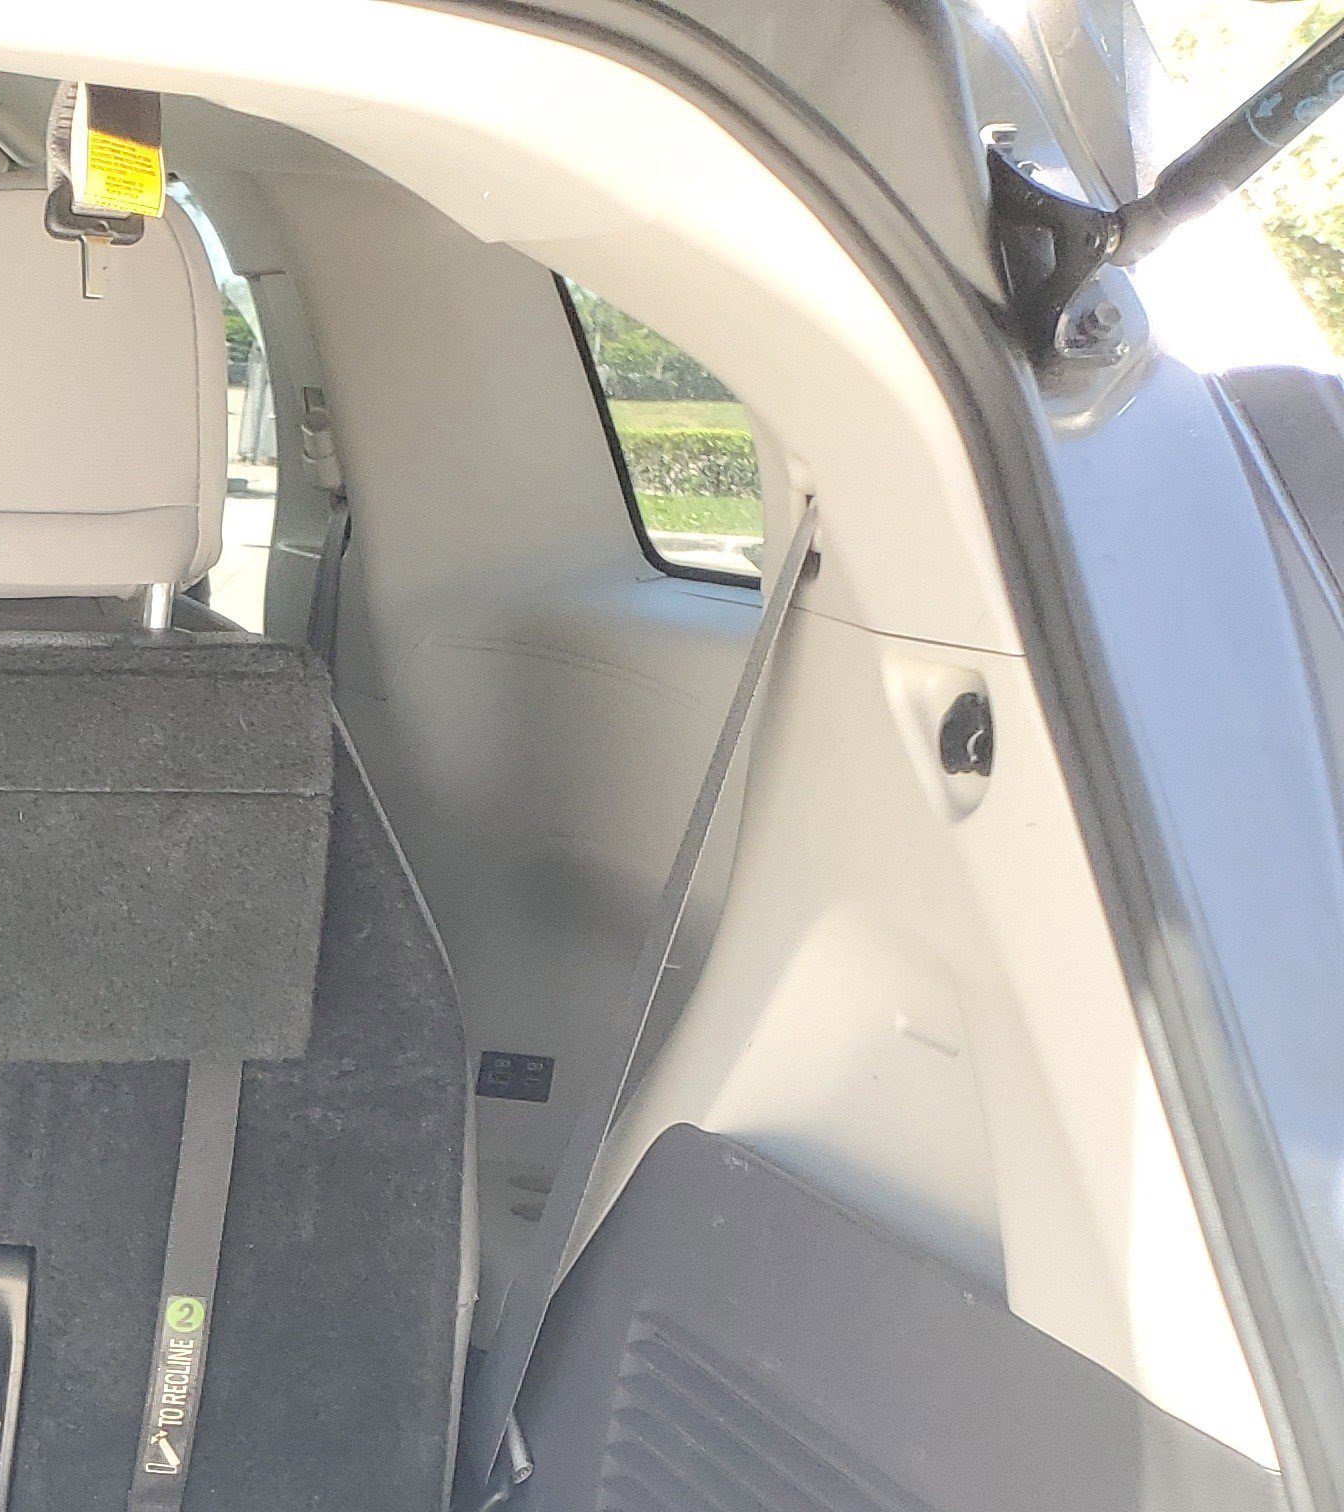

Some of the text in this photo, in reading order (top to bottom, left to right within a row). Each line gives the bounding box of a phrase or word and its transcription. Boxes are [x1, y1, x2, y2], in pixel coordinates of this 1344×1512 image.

[176, 1303, 195, 1328] 2
[158, 1338, 195, 1428] TO RECLINE
